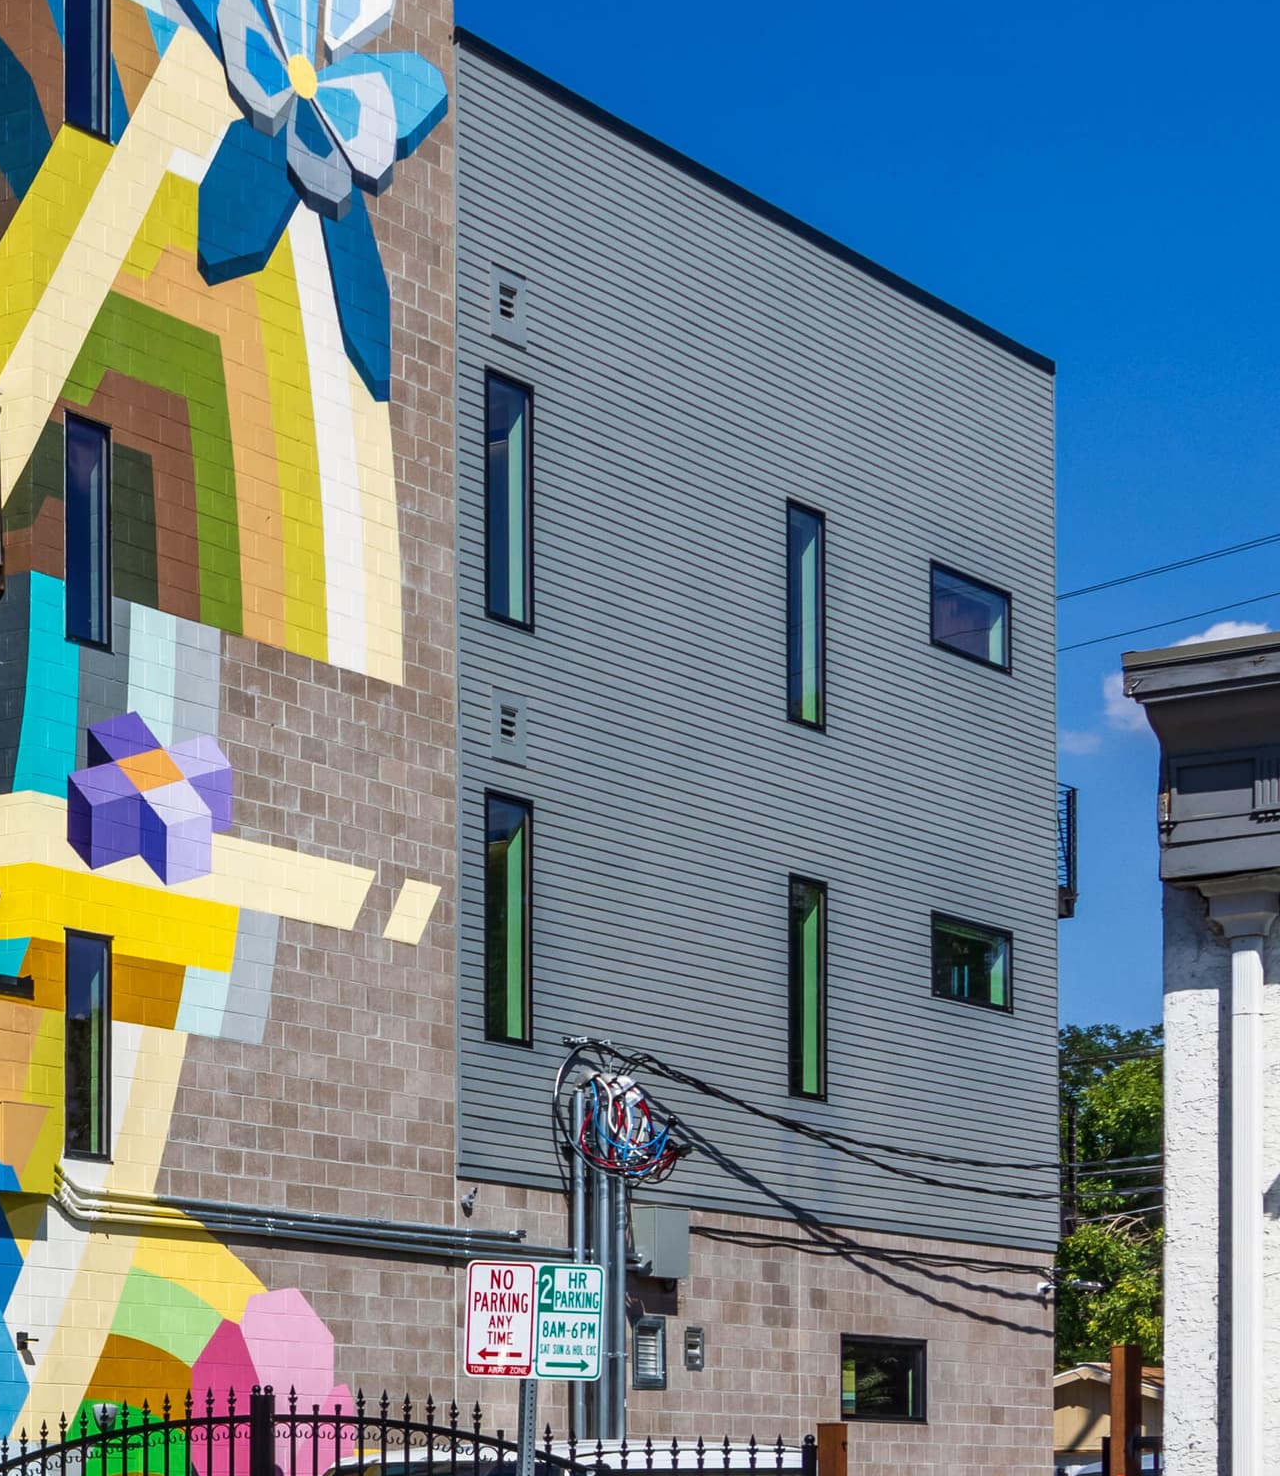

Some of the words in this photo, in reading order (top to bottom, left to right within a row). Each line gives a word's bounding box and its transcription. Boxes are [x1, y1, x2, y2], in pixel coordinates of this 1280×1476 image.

[490, 1269, 514, 1290] NO
[540, 1274, 552, 1304] 2
[568, 1272, 587, 1289] HR
[473, 1292, 529, 1313] PARKING
[554, 1291, 600, 1309] PARKING
[488, 1315, 513, 1329] ANY
[487, 1331, 514, 1345] TIME
[540, 1344, 550, 1354] SAT
[552, 1344, 564, 1355] SUN
[573, 1345, 583, 1355] HOL
[586, 1345, 596, 1356] EXC
[470, 1365, 484, 1373] TOW
[488, 1366, 506, 1374] AWAY
